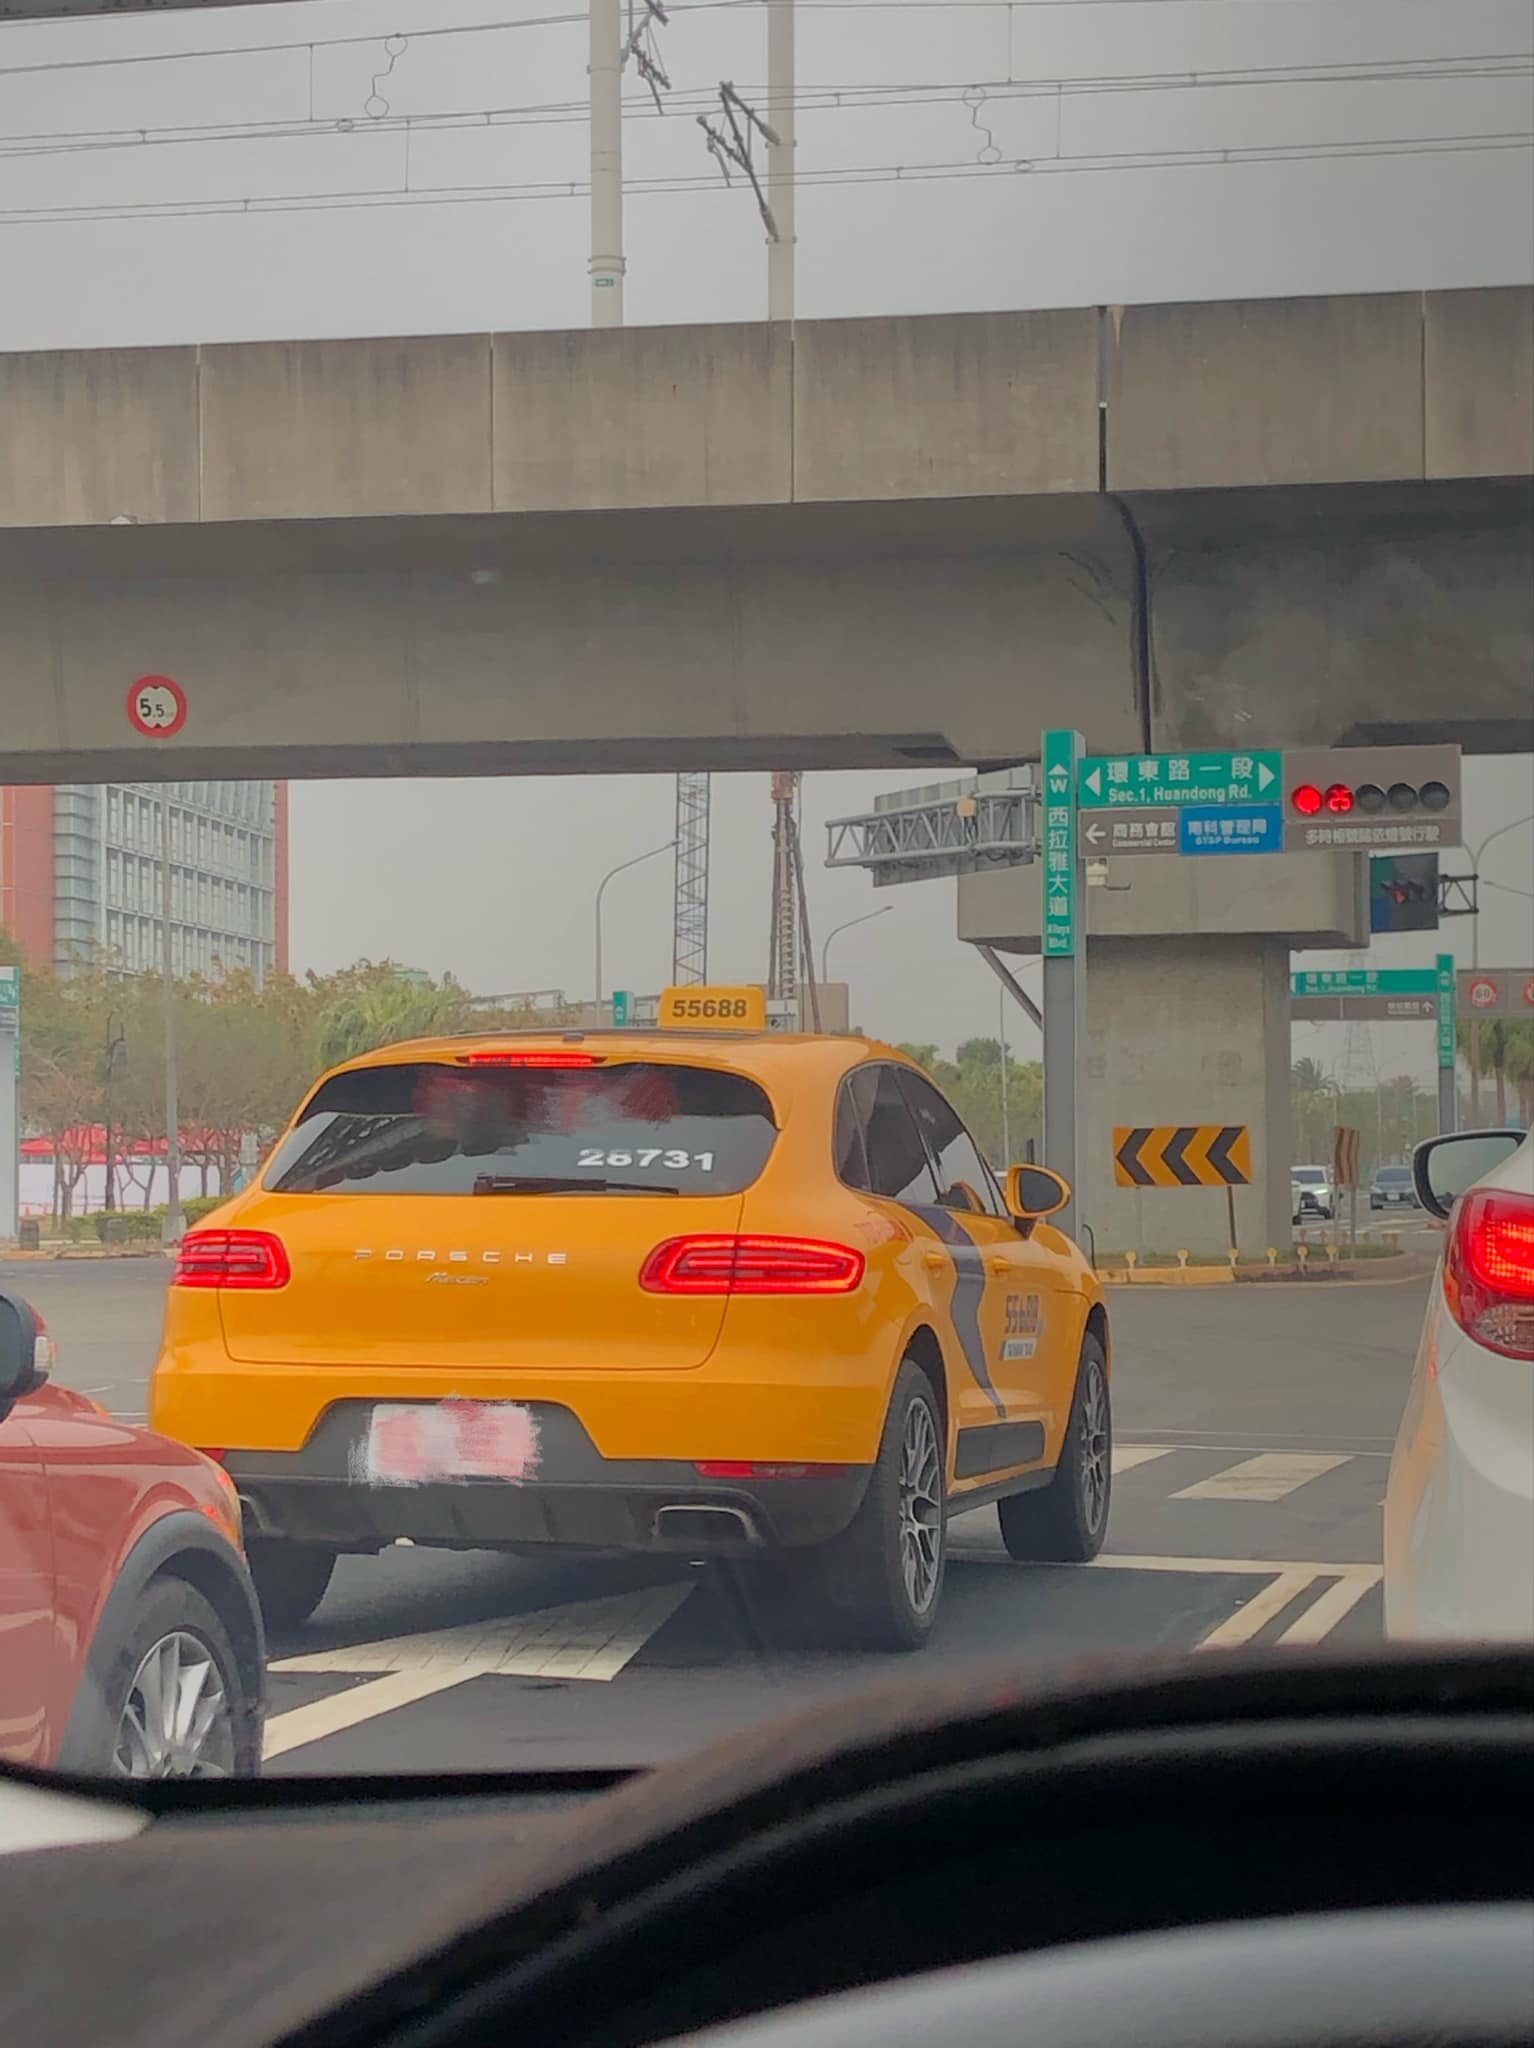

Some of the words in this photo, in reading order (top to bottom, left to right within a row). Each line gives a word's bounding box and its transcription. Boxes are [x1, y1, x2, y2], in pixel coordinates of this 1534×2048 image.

[1107, 757, 1254, 783] 環東路一段
[1049, 778, 1068, 793] W
[1153, 785, 1226, 802] Huandong
[1229, 783, 1253, 800] Rd.
[1048, 806, 1069, 917] 西拉雅大道
[672, 999, 748, 1018] 55688
[354, 1248, 567, 1265] PORSCHE
